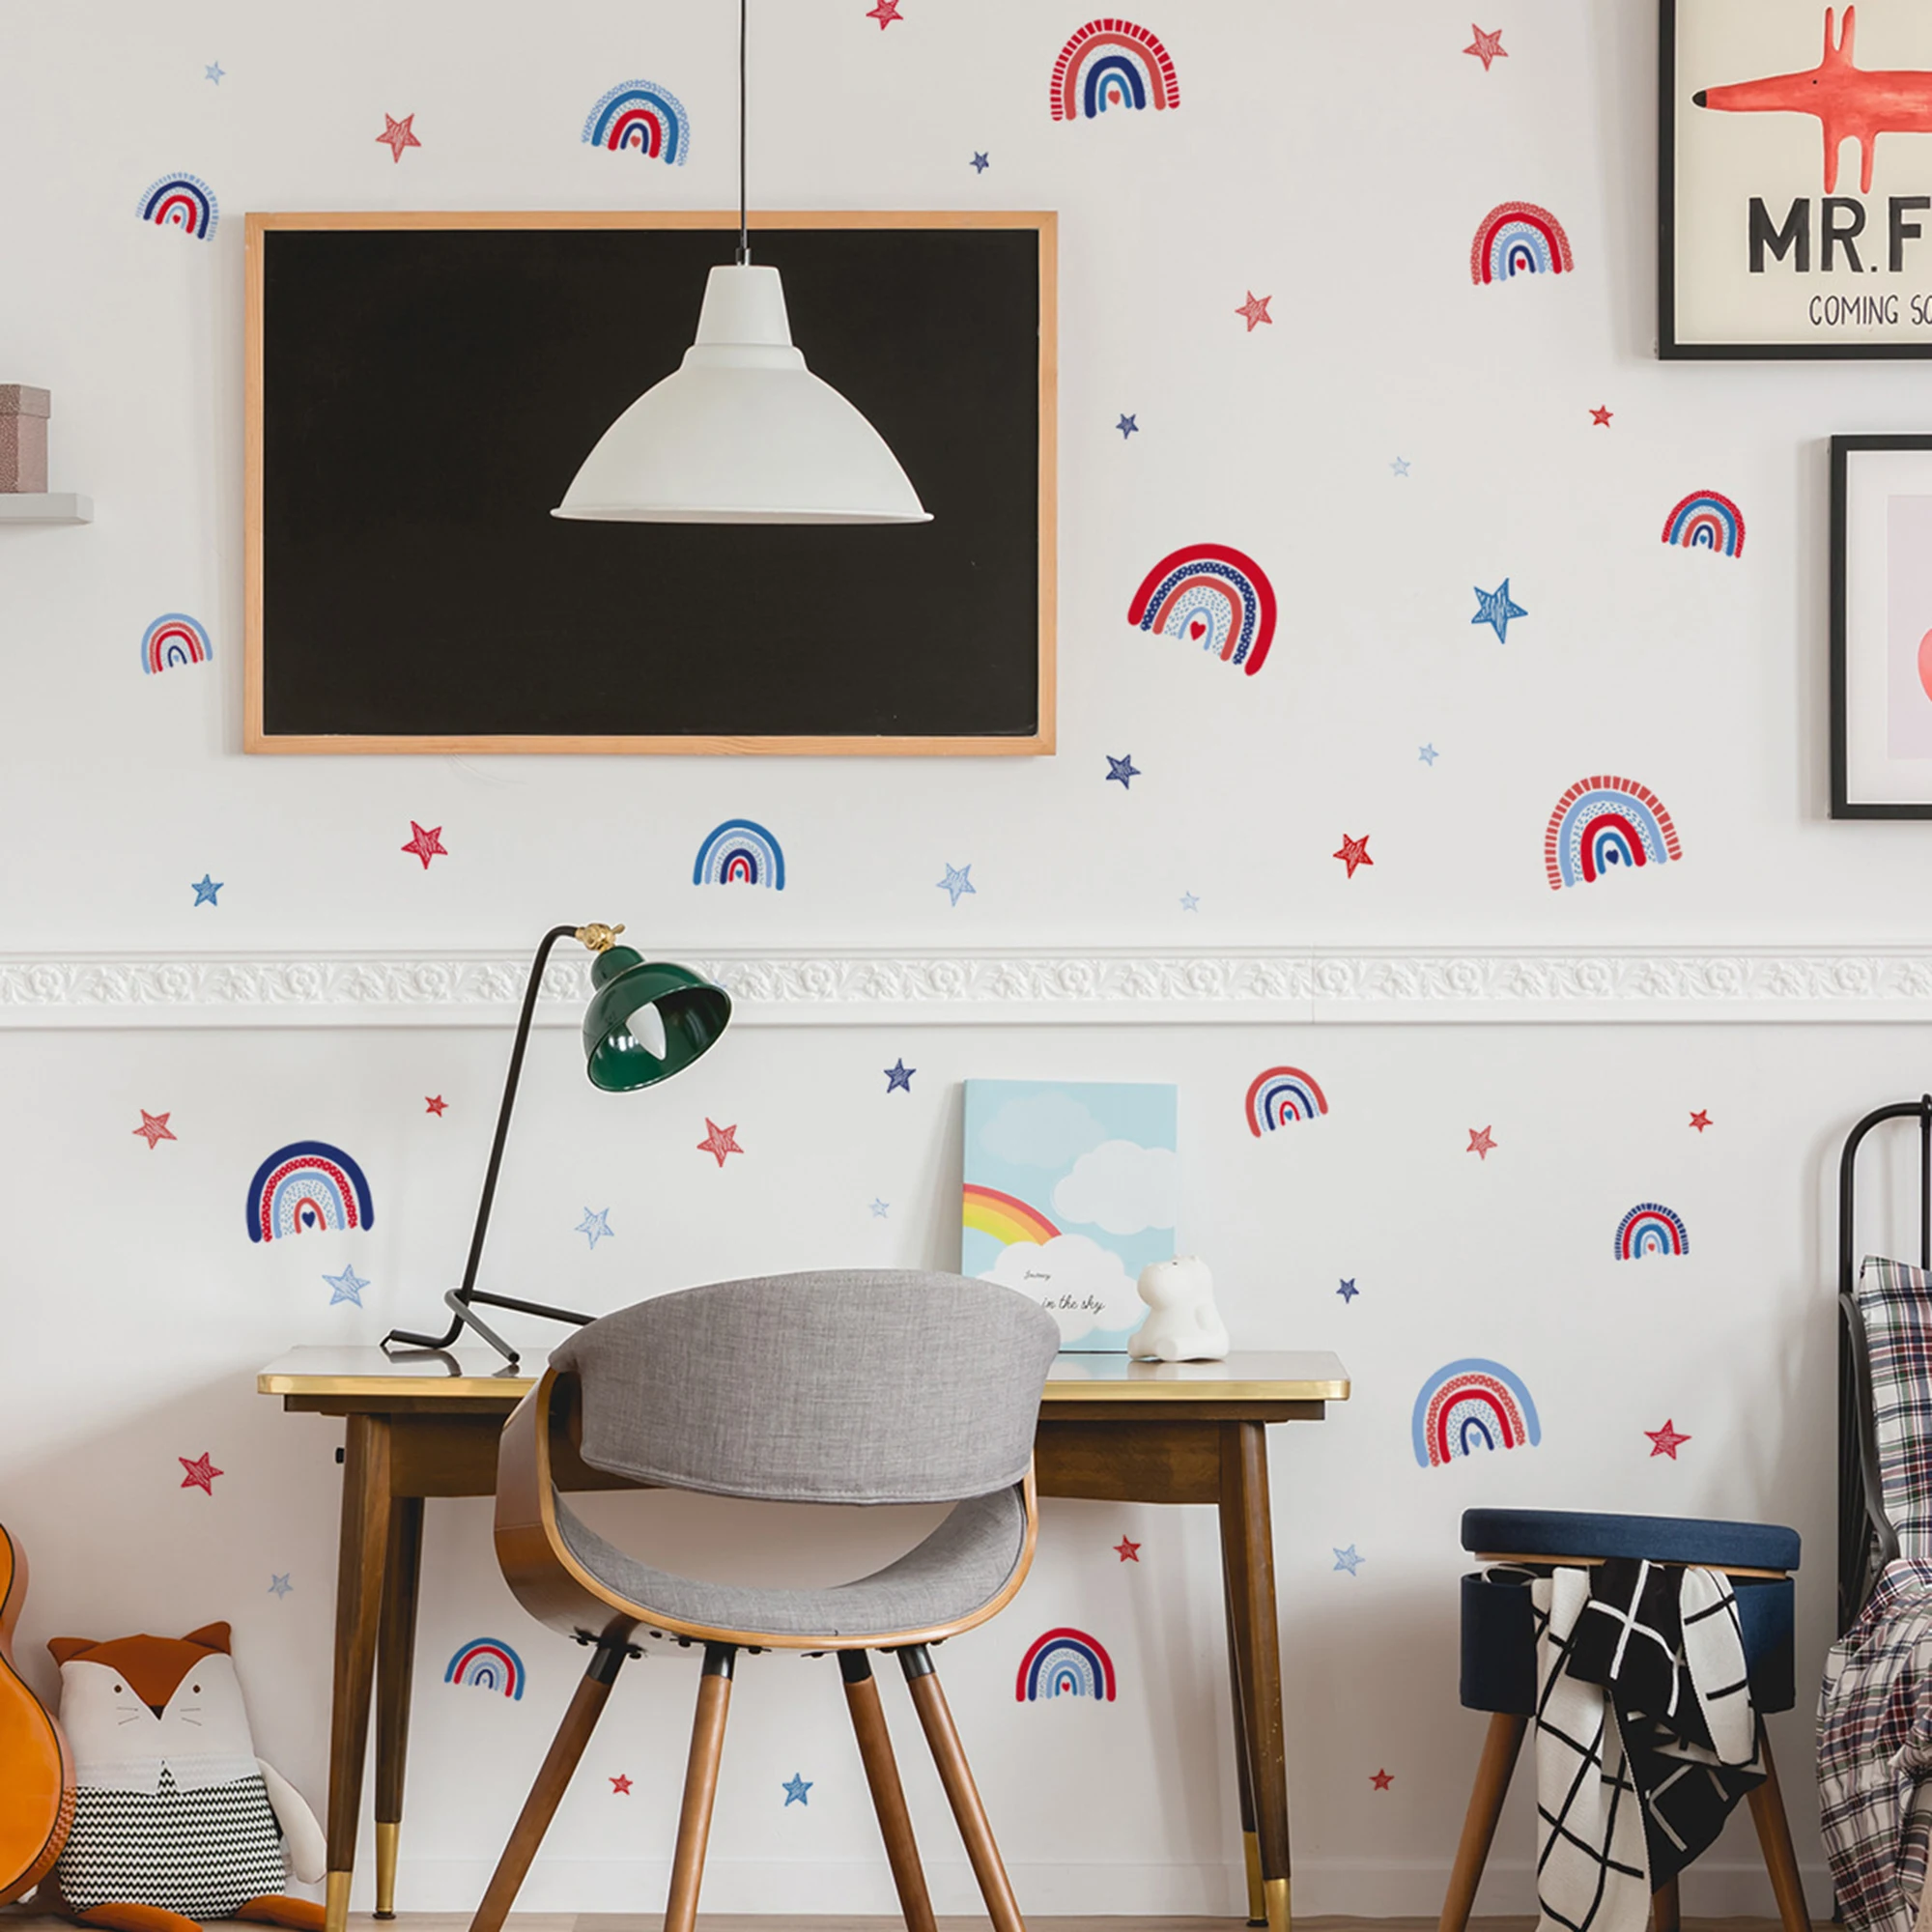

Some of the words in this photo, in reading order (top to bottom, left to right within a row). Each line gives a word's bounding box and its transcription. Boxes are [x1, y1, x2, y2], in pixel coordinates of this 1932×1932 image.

[1809, 294, 1898, 326] COMING
[1059, 1293, 1079, 1310] the
[1081, 1293, 1106, 1315] sky
